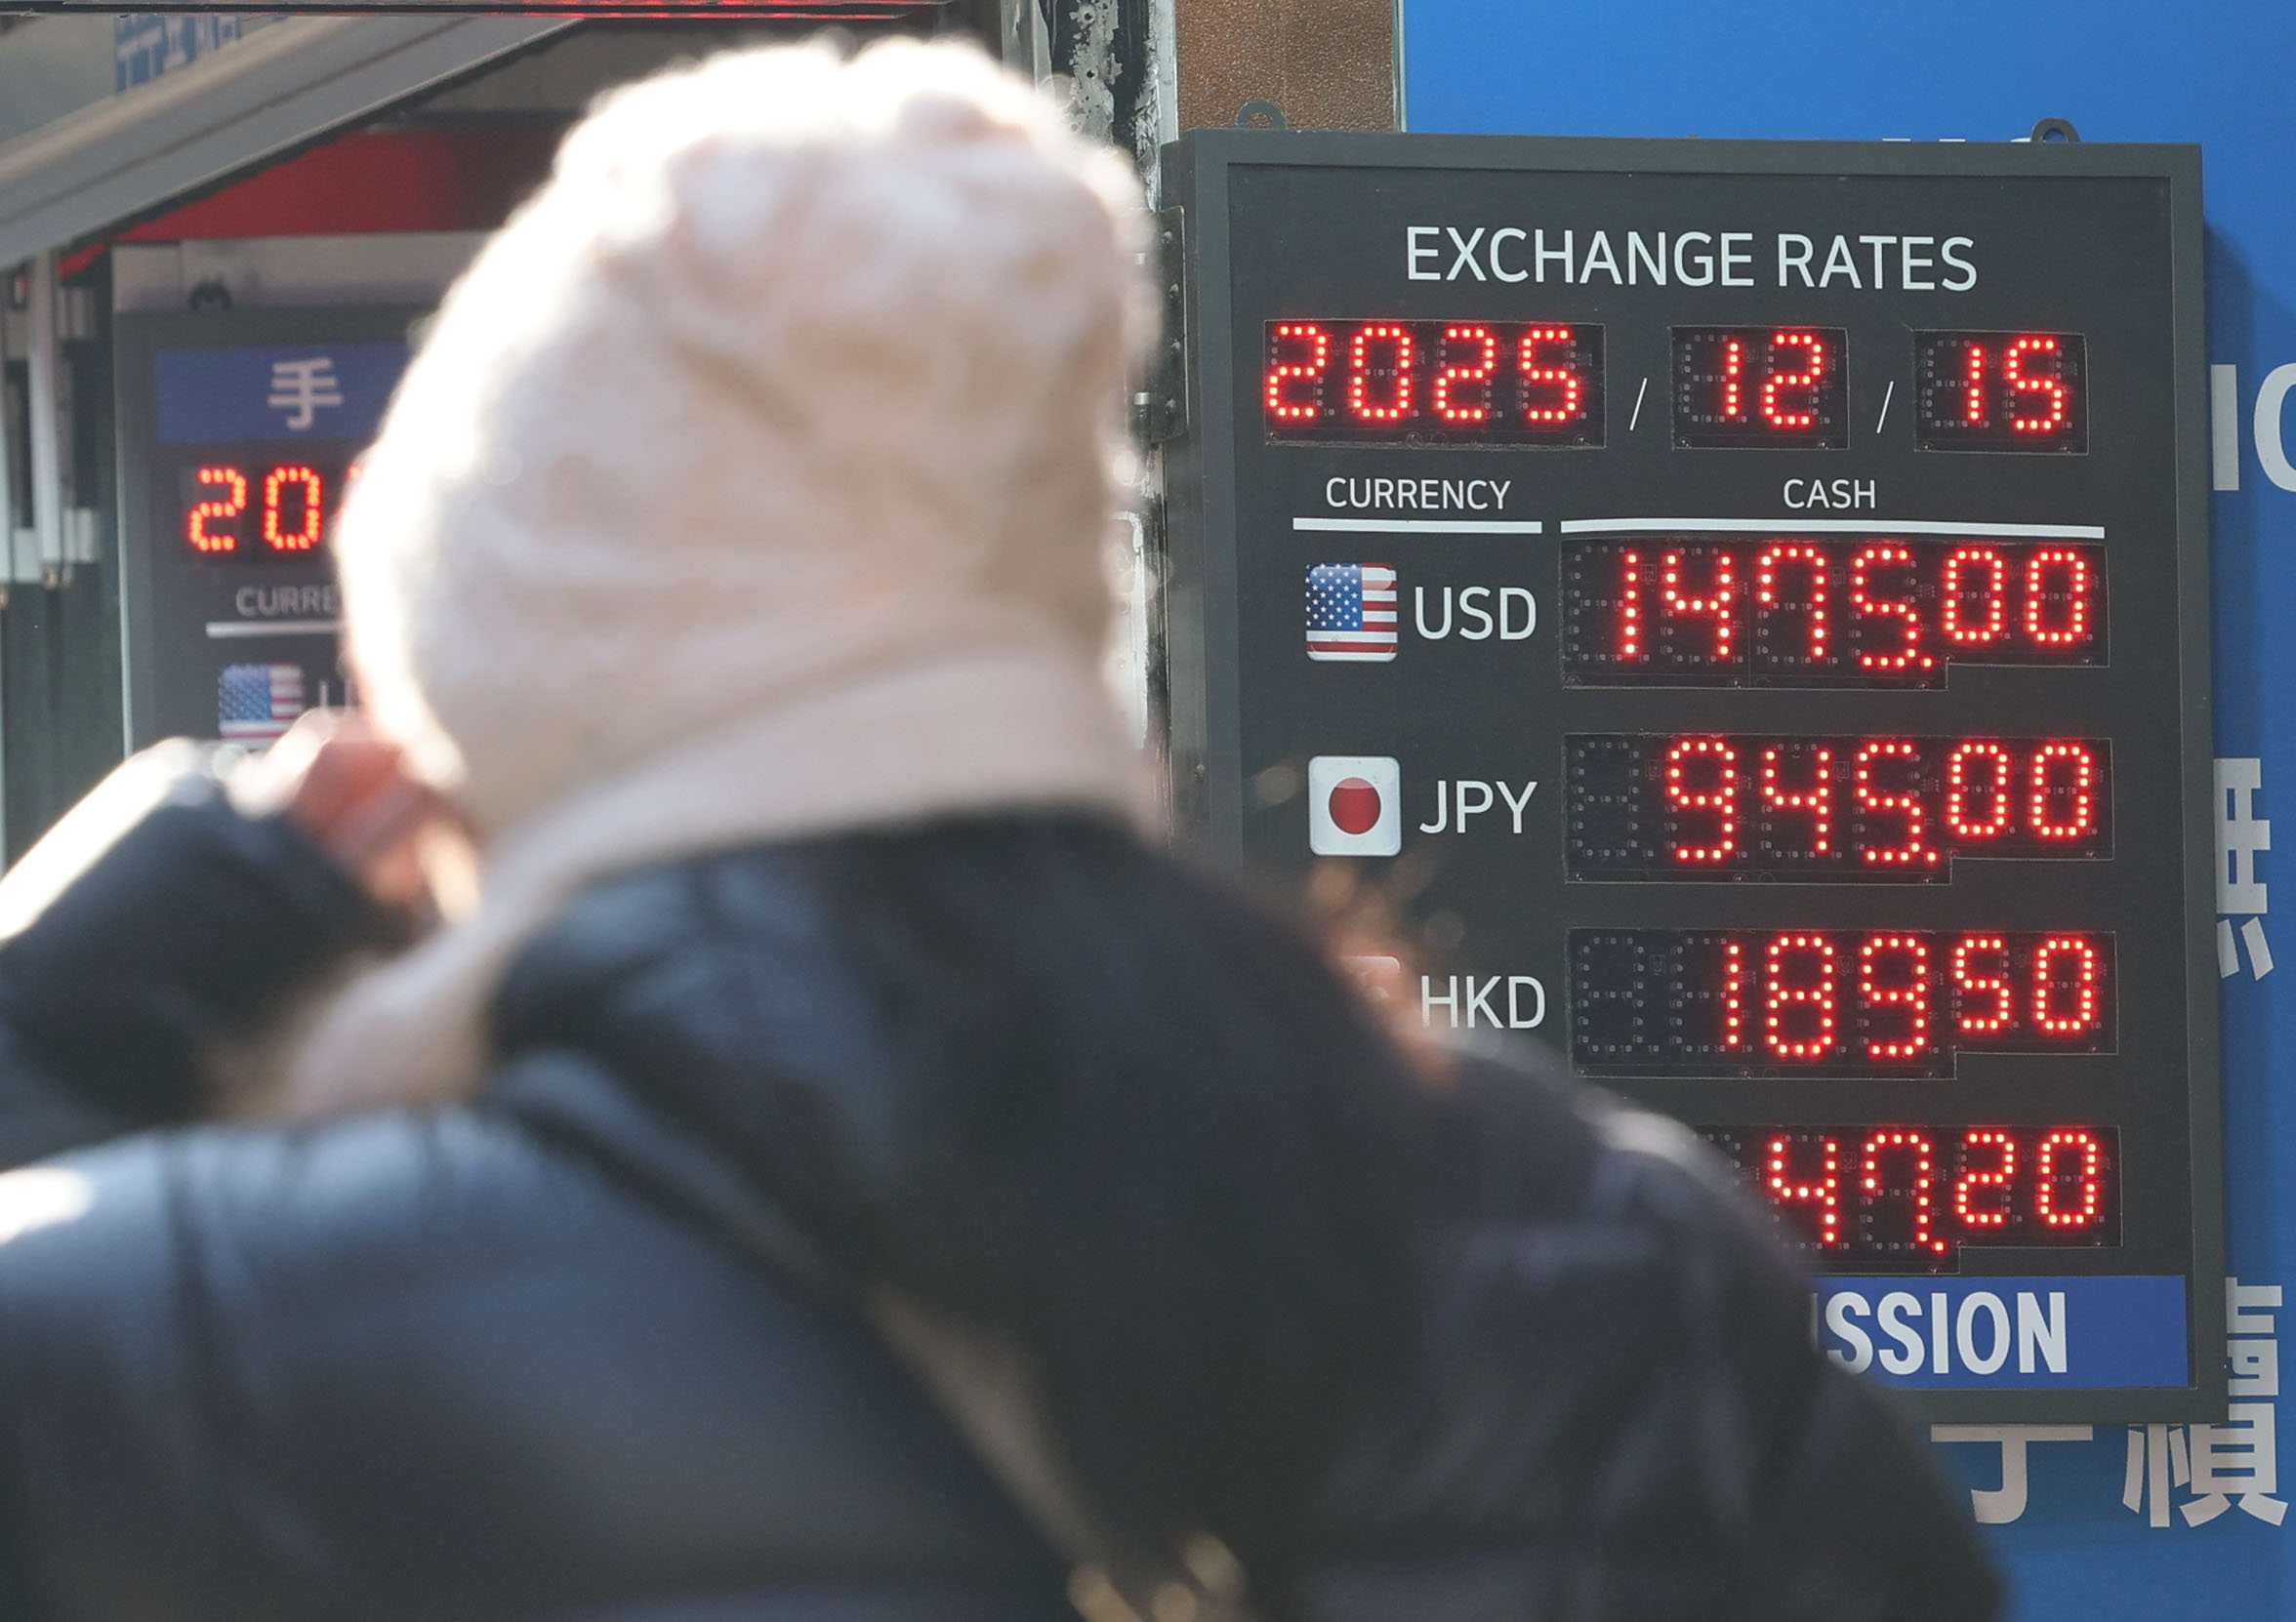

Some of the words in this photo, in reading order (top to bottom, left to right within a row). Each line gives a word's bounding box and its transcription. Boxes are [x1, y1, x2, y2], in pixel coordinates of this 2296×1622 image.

[1406, 225, 1754, 287] EXCHANGE
[1777, 232, 1978, 292] RATES
[268, 357, 344, 428] 手
[1266, 321, 1579, 422] 2025
[1724, 331, 1824, 427] 12
[1966, 335, 2068, 433] 15
[187, 466, 359, 551] 20
[1325, 476, 1511, 510] CURRENCY
[1783, 478, 1876, 509] CASH
[1414, 586, 1538, 641] USD
[1418, 780, 1538, 834] JPY
[1420, 975, 1546, 1030] HKD
[1811, 1290, 2069, 1376] SSION
